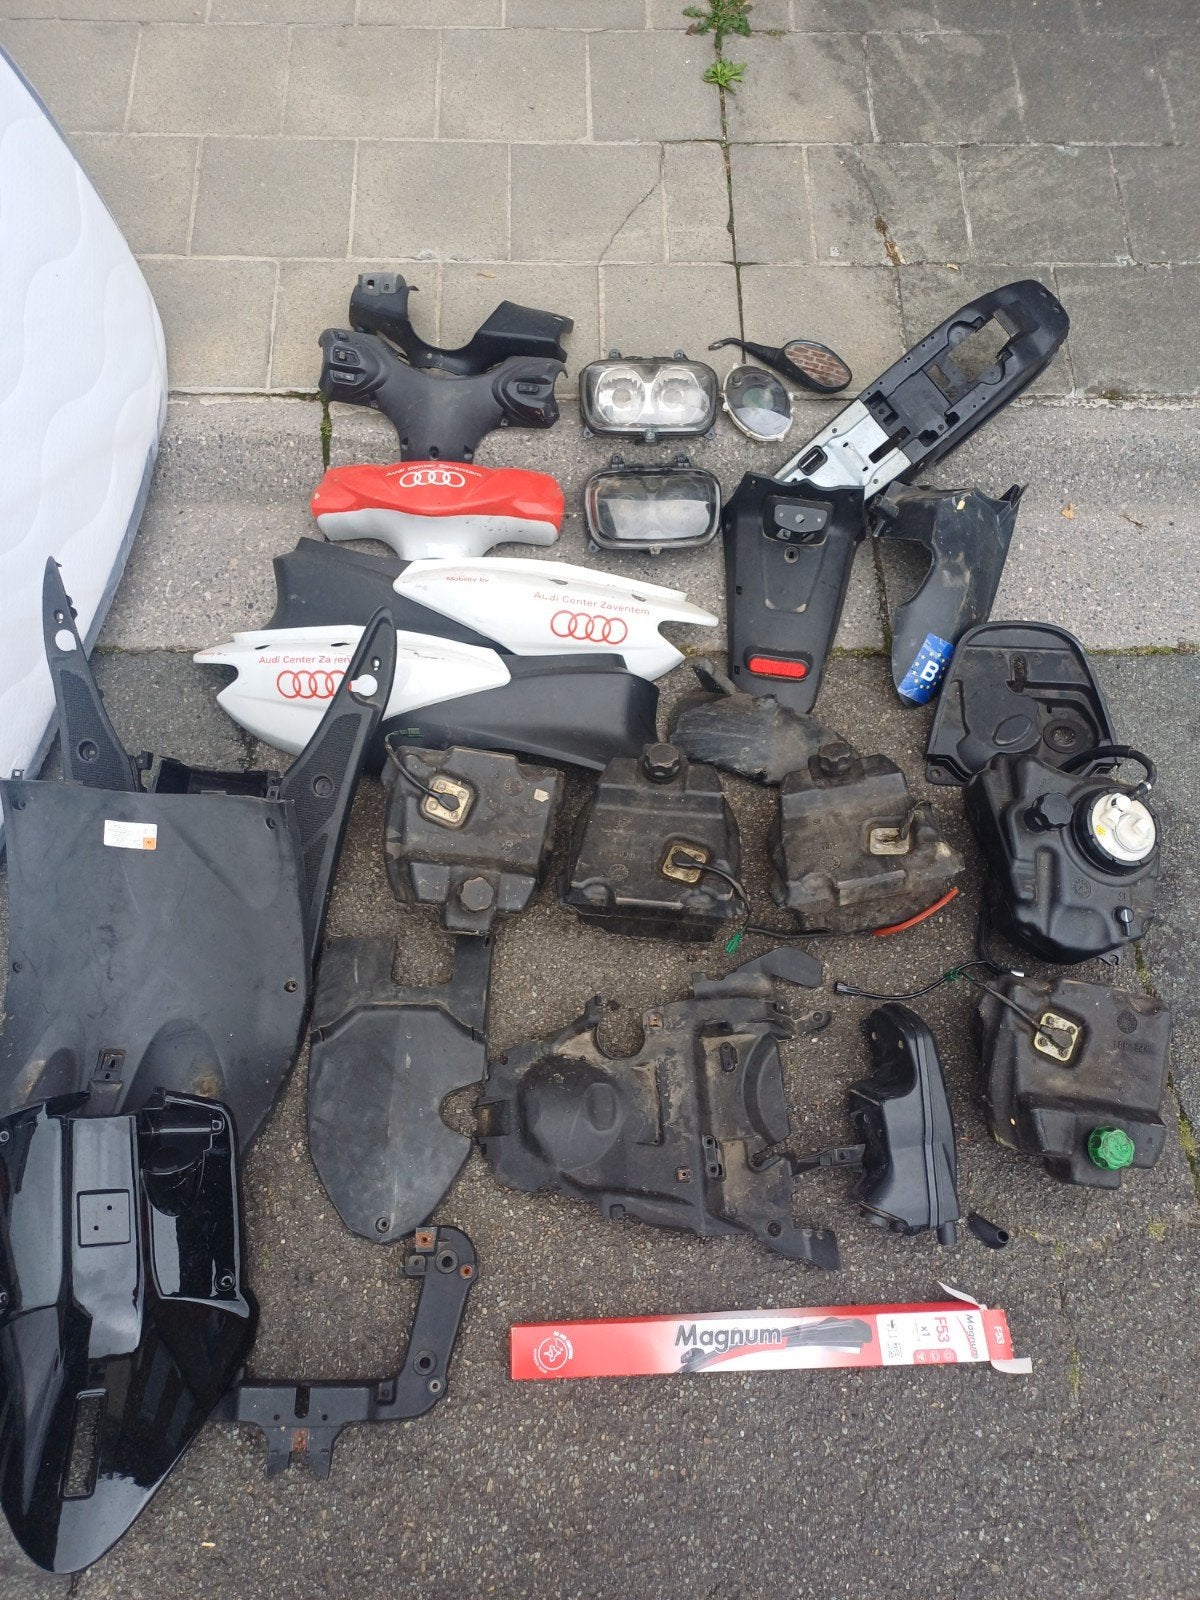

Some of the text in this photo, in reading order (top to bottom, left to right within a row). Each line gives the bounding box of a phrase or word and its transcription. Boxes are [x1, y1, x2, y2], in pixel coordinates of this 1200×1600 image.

[385, 467, 406, 477] Audi
[438, 463, 482, 477] Zaventem
[533, 591, 650, 616] Audi Center Zaventem
[258, 655, 281, 664] Audi
[283, 655, 316, 664] Center
[920, 659, 940, 682] B
[674, 1323, 781, 1354] Magnum
[934, 1316, 950, 1343] F53
[966, 1314, 978, 1359] Magnum
[993, 1326, 1005, 1345] F53
